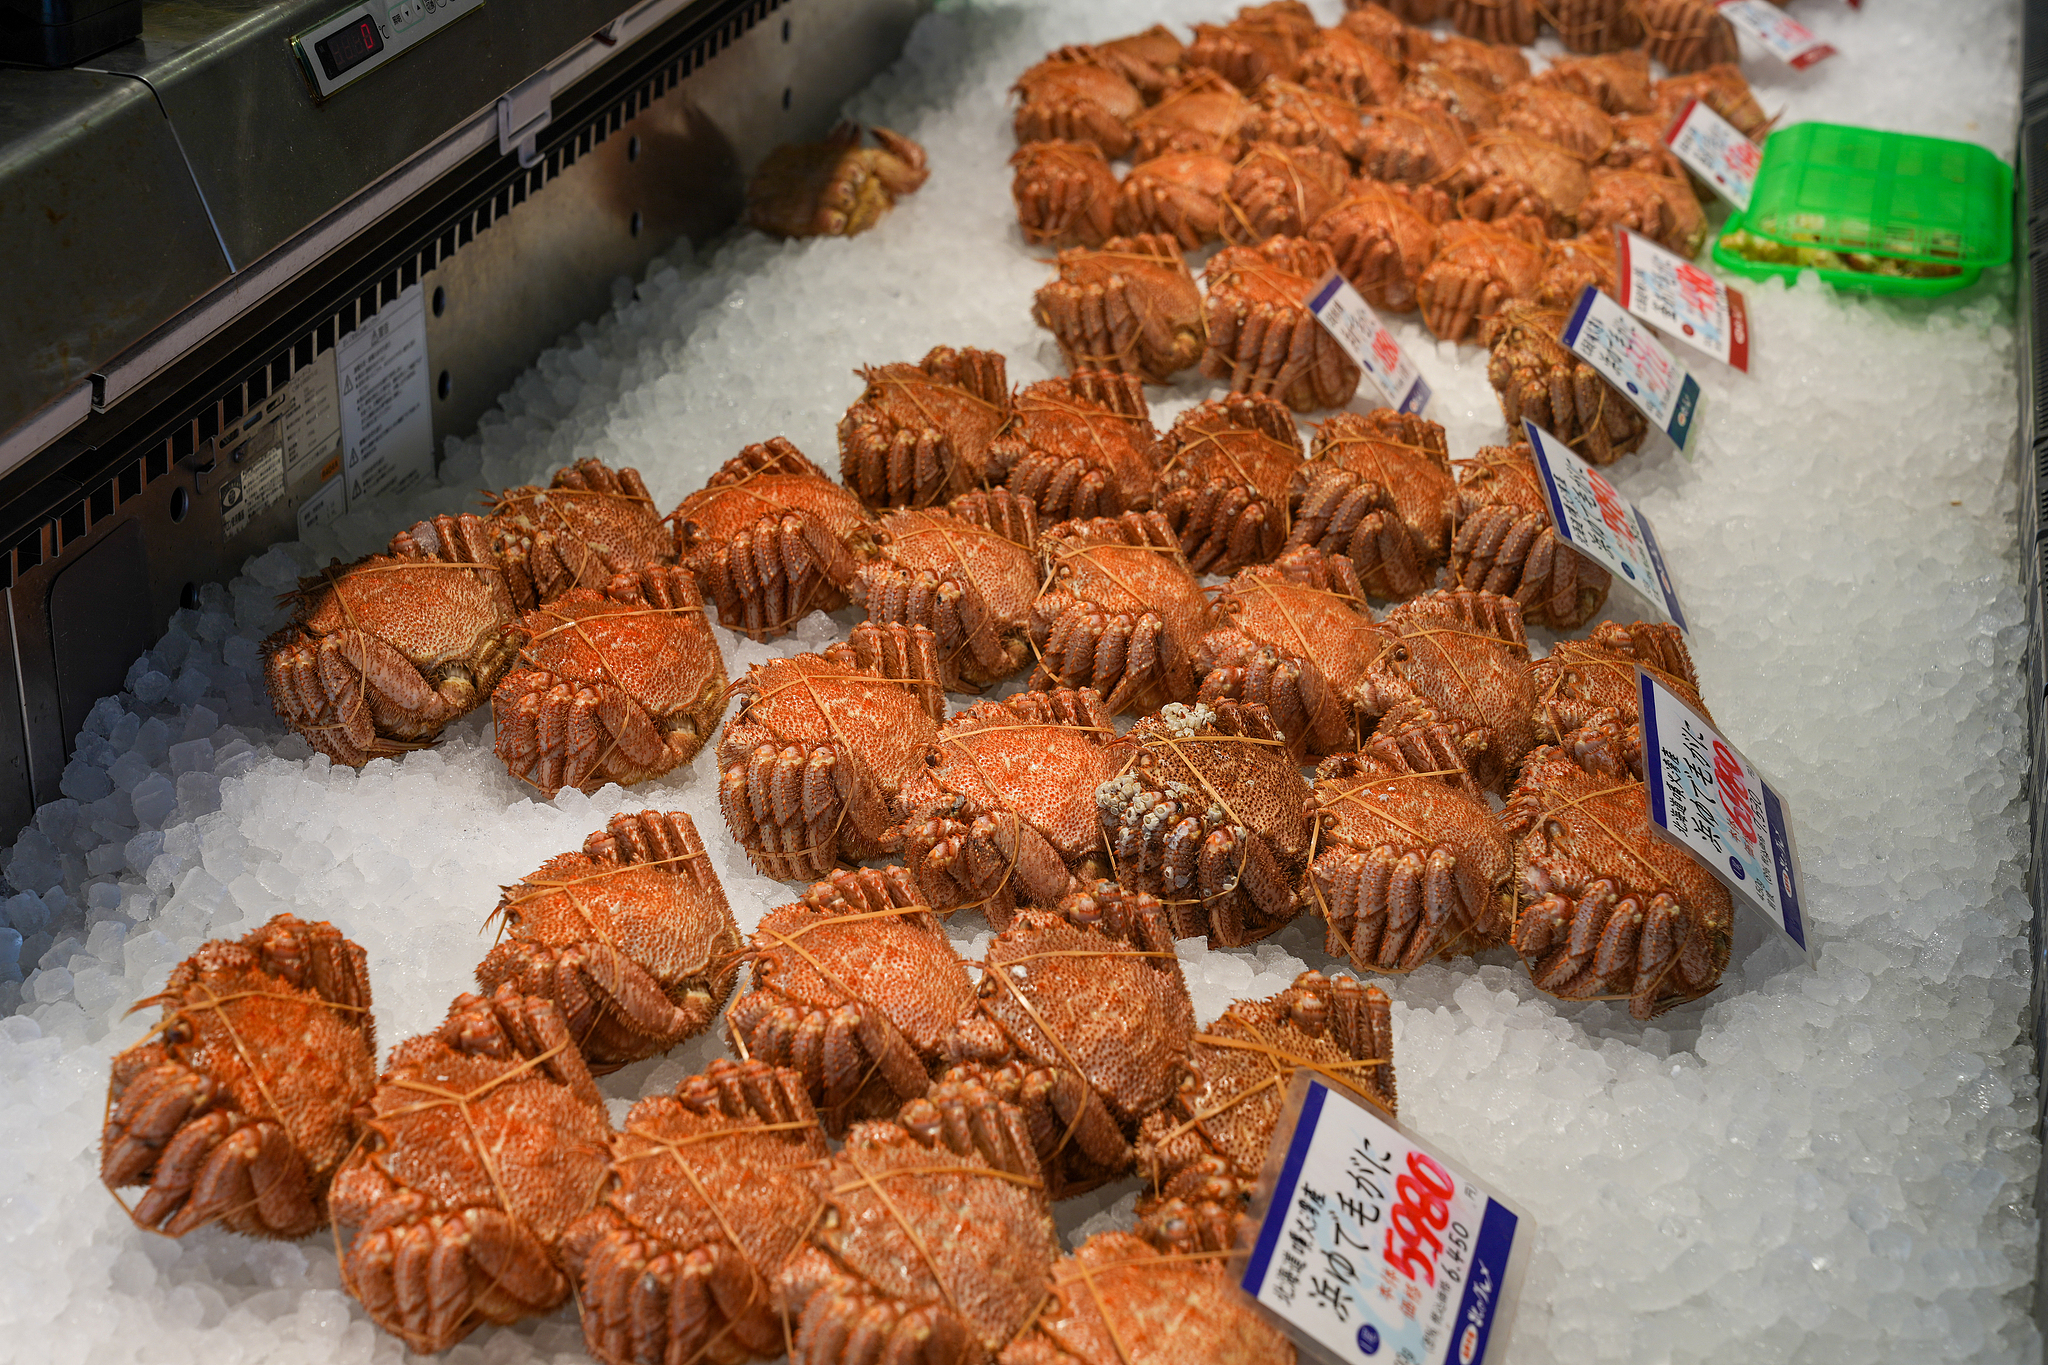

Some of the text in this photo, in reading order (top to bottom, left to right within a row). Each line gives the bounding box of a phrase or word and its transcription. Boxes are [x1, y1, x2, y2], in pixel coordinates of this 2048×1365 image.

[1681, 720, 1721, 853] 浜ゆで毛がに
[1309, 1138, 1391, 1322] 浜ゆで毛がに
[1379, 1269, 1399, 1301] 本体
[1400, 1284, 1423, 1321] 価格
